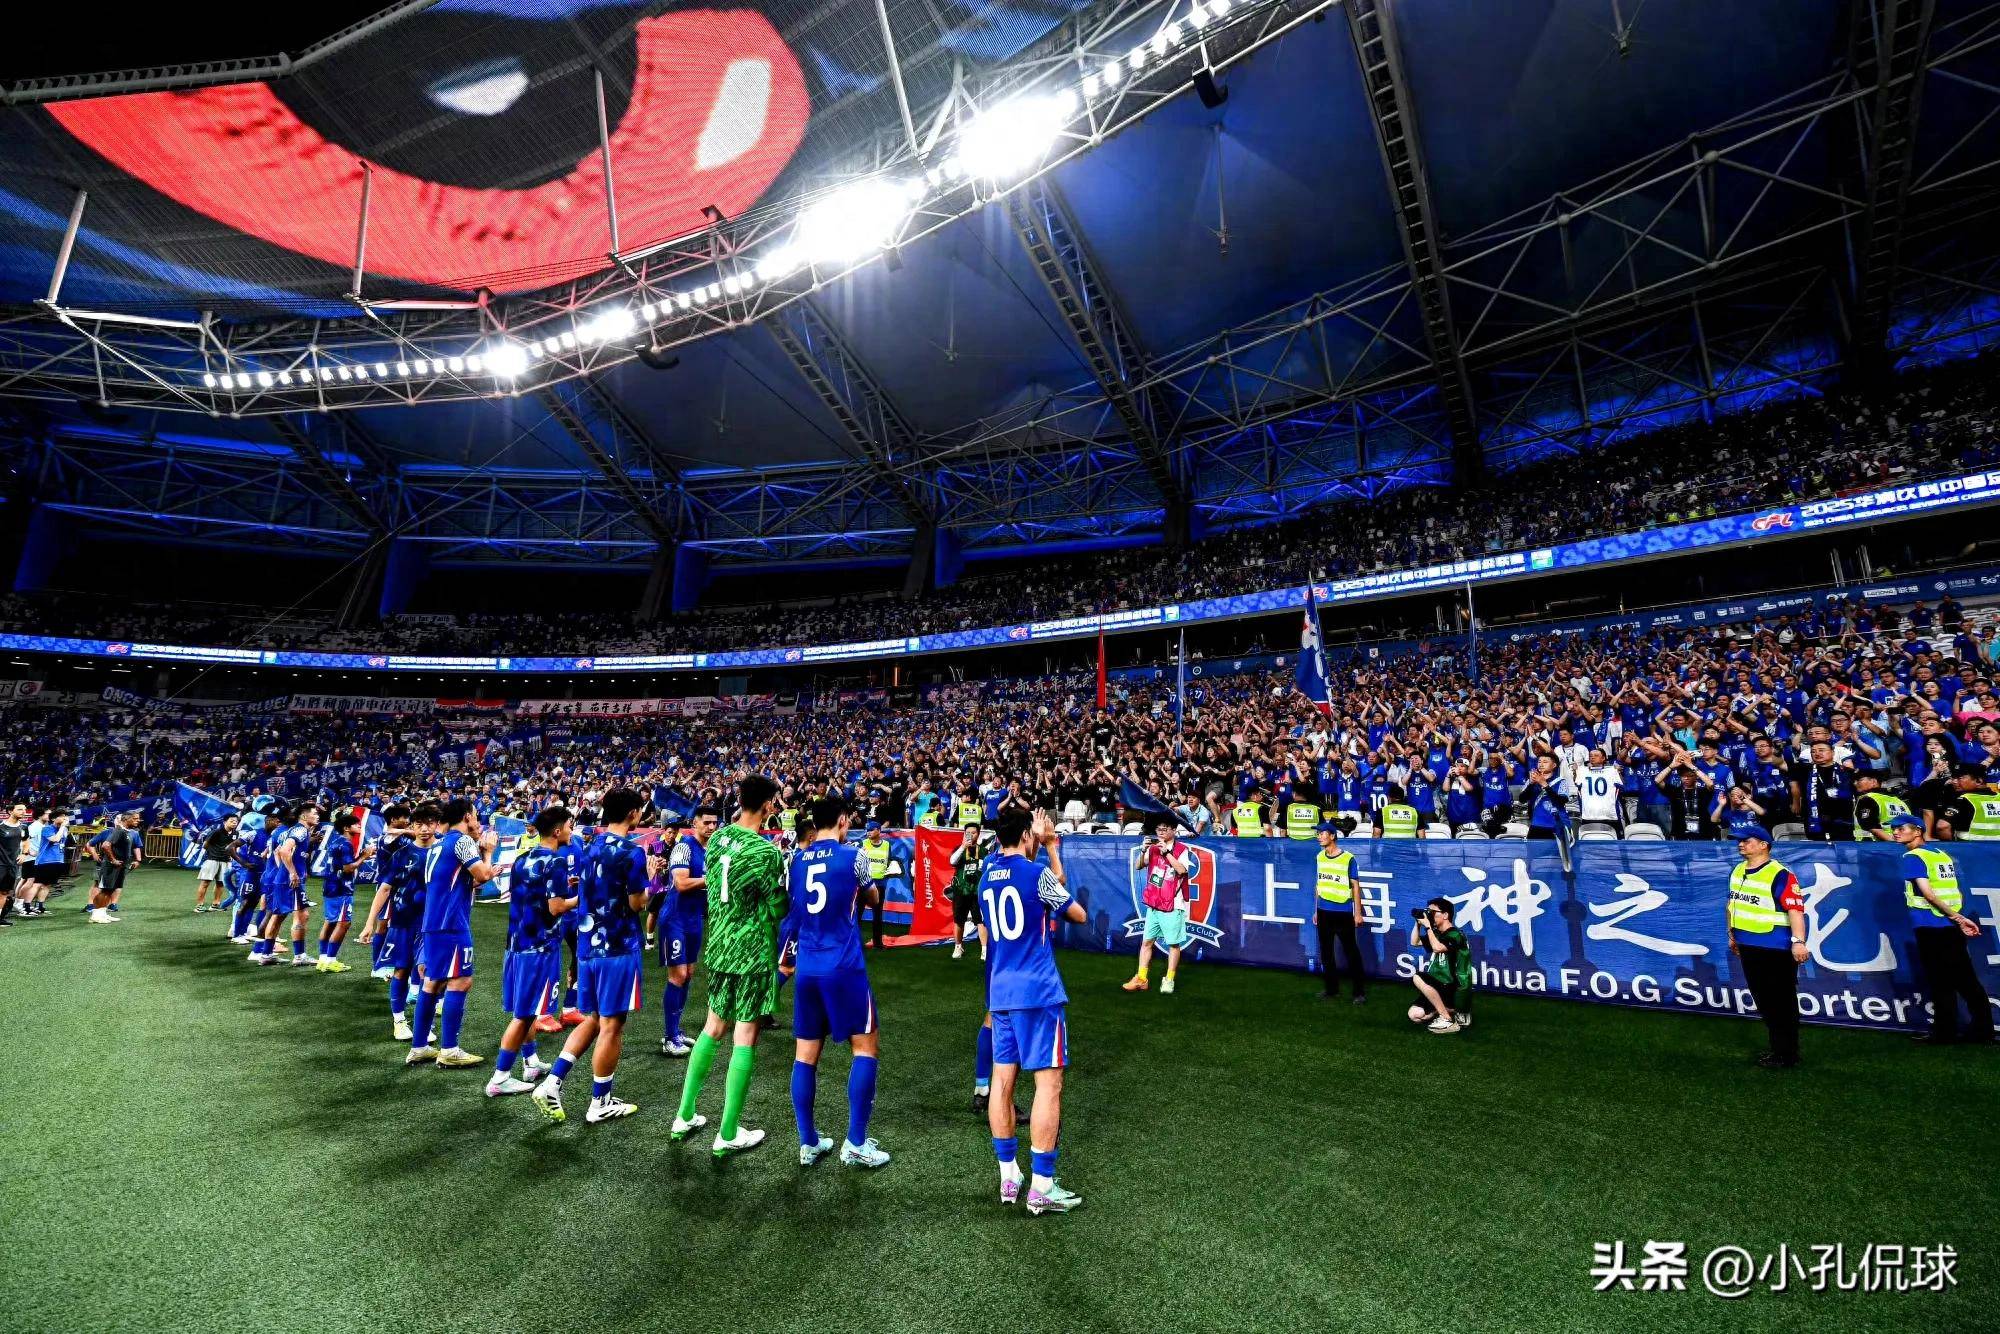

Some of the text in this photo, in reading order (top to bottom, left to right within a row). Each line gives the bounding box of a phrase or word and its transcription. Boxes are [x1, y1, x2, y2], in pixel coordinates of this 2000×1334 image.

[1585, 776, 1608, 796] 10
[1370, 794, 1389, 811] 10
[424, 845, 443, 883] 17
[720, 855, 731, 903] 1
[805, 863, 827, 914] 5
[982, 885, 1025, 942] 10
[1196, 926, 1215, 938] Club
[384, 943, 395, 958] 7
[672, 939, 681, 954] 9
[551, 981, 559, 999] 6
[1395, 953, 1935, 1026] Shhua F.O.G Suporter's
